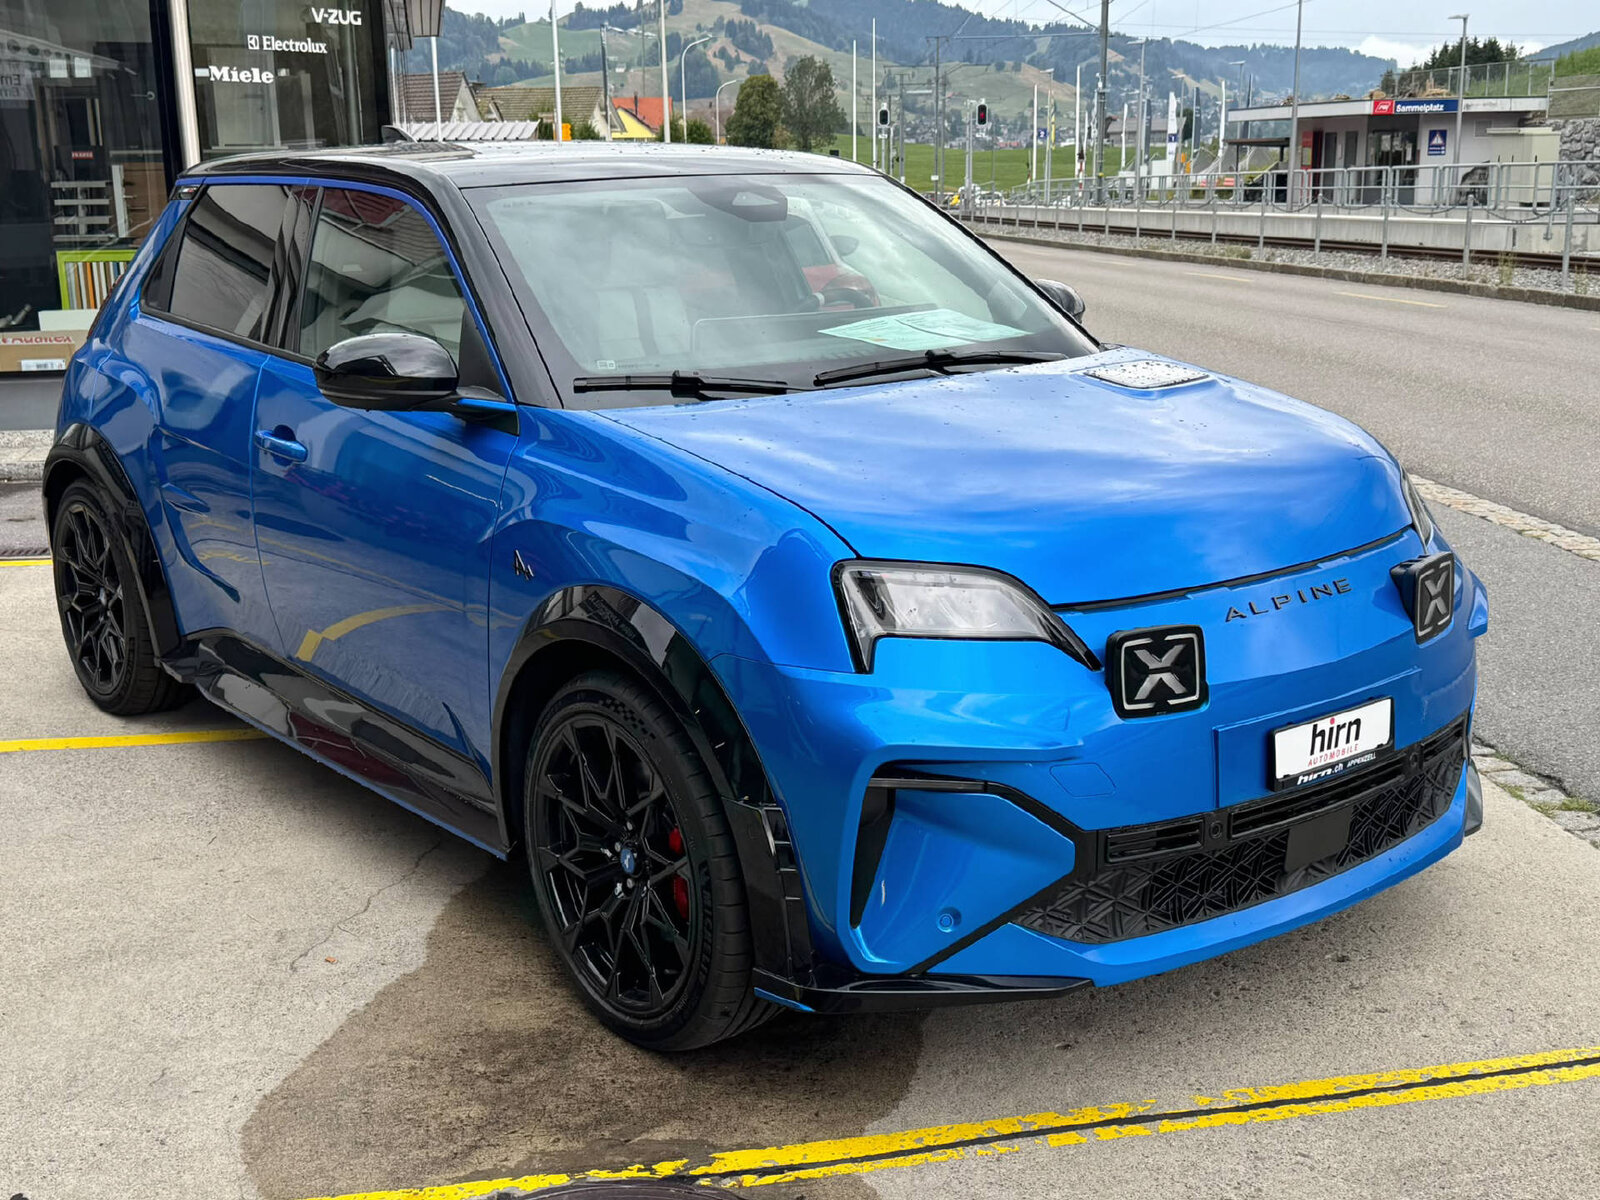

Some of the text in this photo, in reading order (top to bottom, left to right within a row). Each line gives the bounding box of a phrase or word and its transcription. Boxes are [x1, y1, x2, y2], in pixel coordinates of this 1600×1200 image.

[311, 7, 362, 26] V-ZUG
[262, 35, 328, 54] Electrolux
[208, 65, 274, 84] Miele
[1395, 103, 1445, 113] Sammelplatz
[1225, 578, 1352, 622] ALPINE
[1309, 717, 1362, 756] hirn
[1307, 743, 1360, 768] AUTOMOBILE
[1296, 762, 1344, 786] hirn.ch
